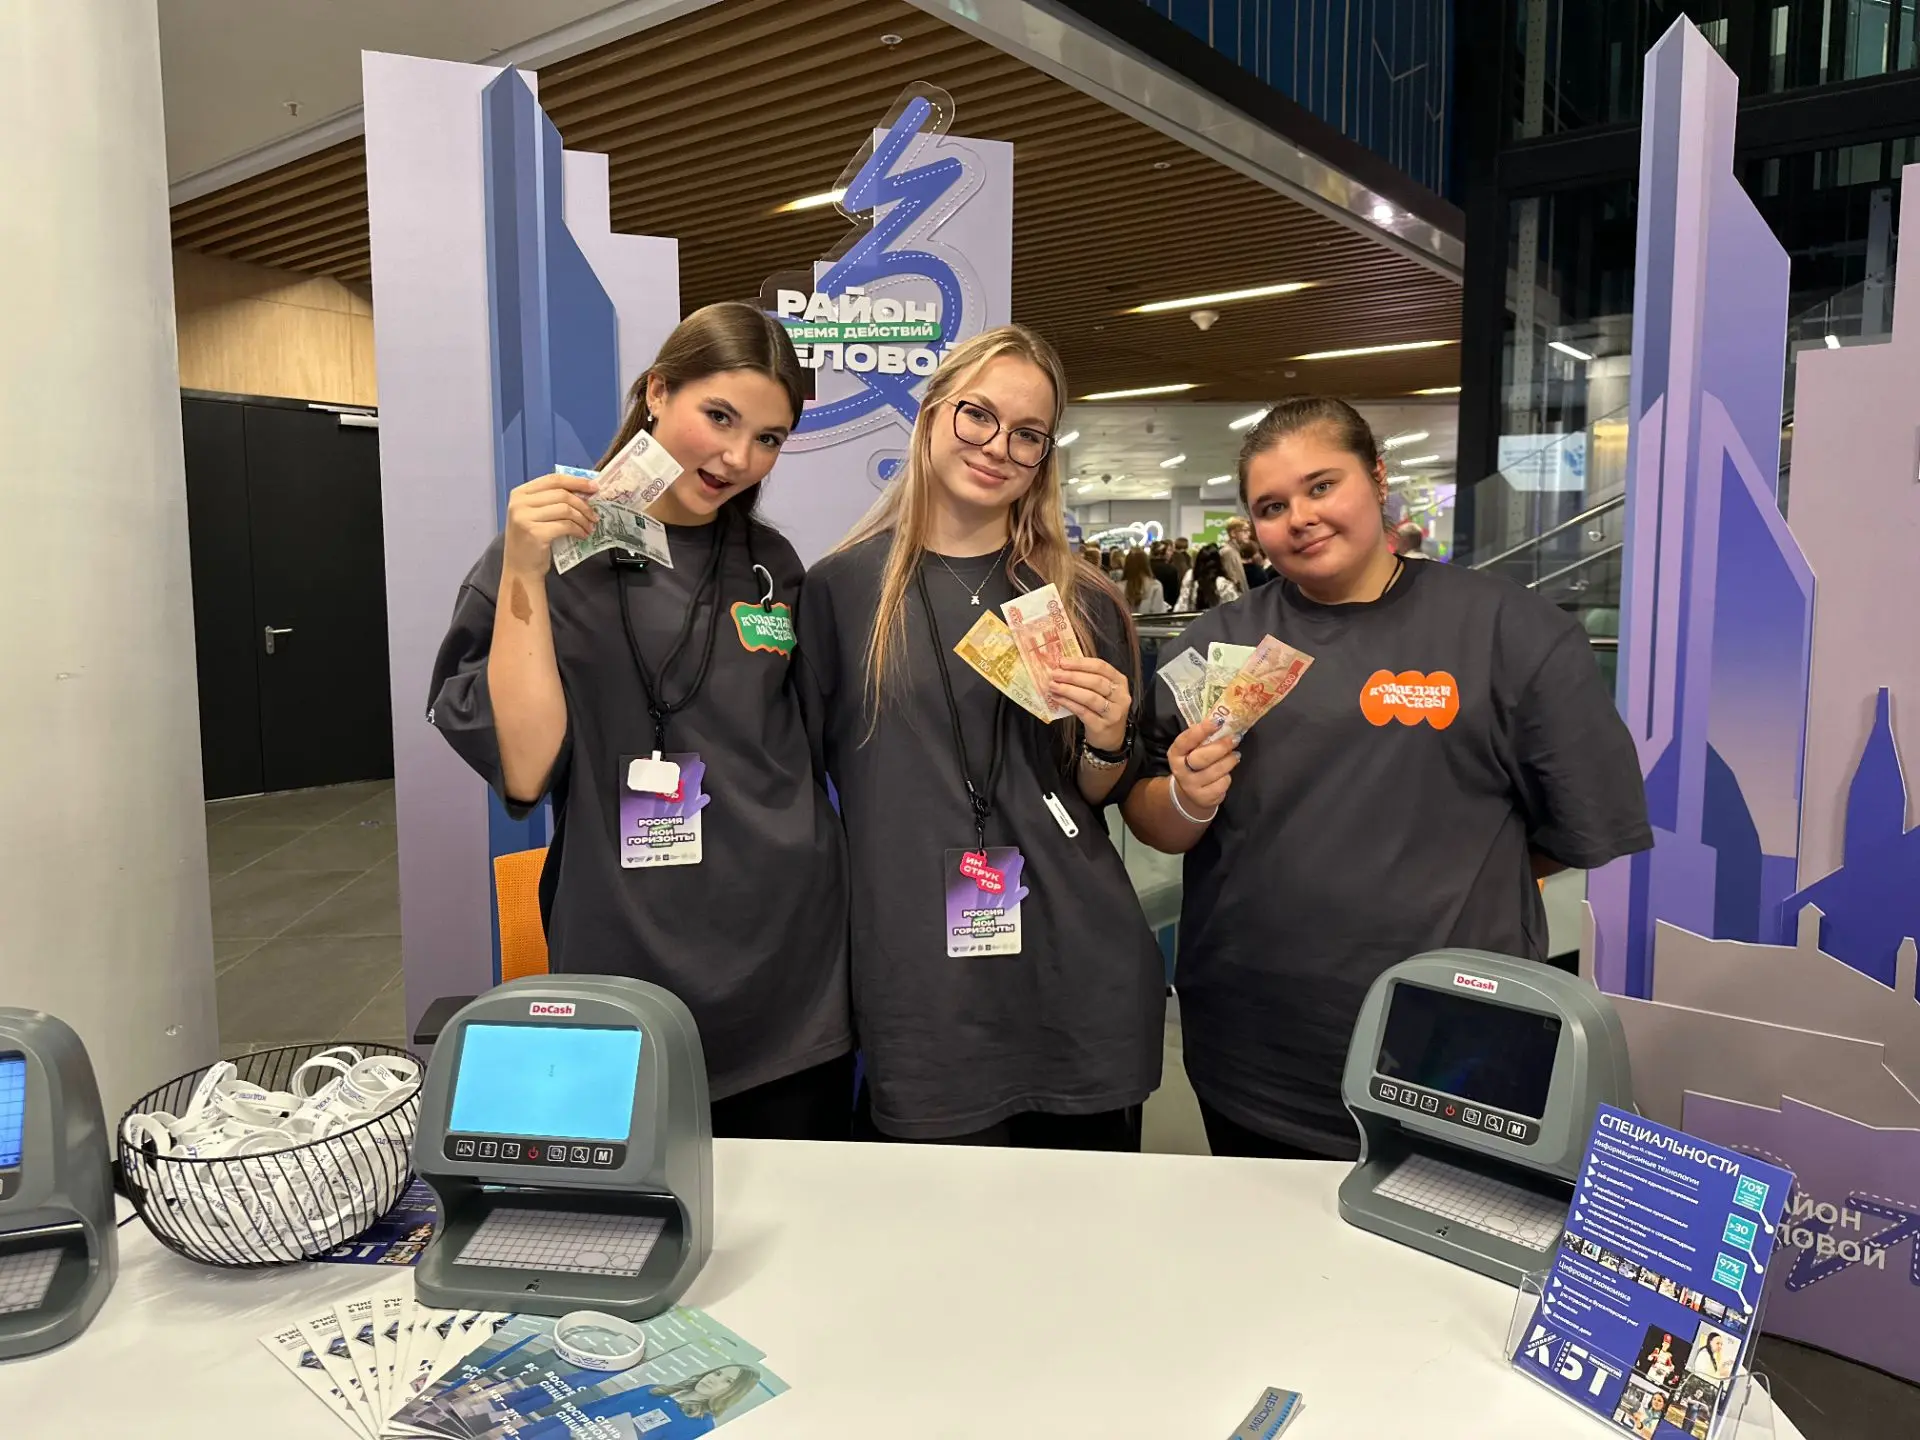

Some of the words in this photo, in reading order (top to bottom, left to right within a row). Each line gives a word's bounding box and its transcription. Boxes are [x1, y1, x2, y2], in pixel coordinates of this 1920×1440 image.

[777, 286, 936, 324] РАЙОН
[844, 322, 933, 339] ДЕЙСТВИЙ
[796, 342, 957, 376] ЕЛОВО
[641, 478, 665, 502] 500
[1369, 683, 1452, 697] КОЛЛЕДЖИ
[1383, 694, 1446, 708] МОСКВЫ
[638, 817, 684, 827] РОССИЯ
[628, 834, 694, 845] ГОРИЗОНТЫ
[965, 857, 983, 867] ИН
[963, 866, 1000, 881] СТРУК
[980, 879, 1001, 890] ТОР
[963, 909, 1004, 918] РОССИЯ
[954, 925, 1015, 935] ГОРИЗОНТЫ
[1456, 976, 1495, 991] DoCash
[532, 1005, 573, 1015] DoCash
[1600, 1113, 1740, 1177] СПЕЦИАЛЬНОСТИ
[598, 1151, 608, 1161] M
[1656, 1163, 1700, 1186] технологии
[1742, 1179, 1763, 1196] 70%
[1728, 1222, 1749, 1235] >30
[1719, 1258, 1740, 1275] 97%
[1591, 1279, 1632, 1302] экономика
[561, 1402, 611, 1440] ВОСТРЕБОВ
